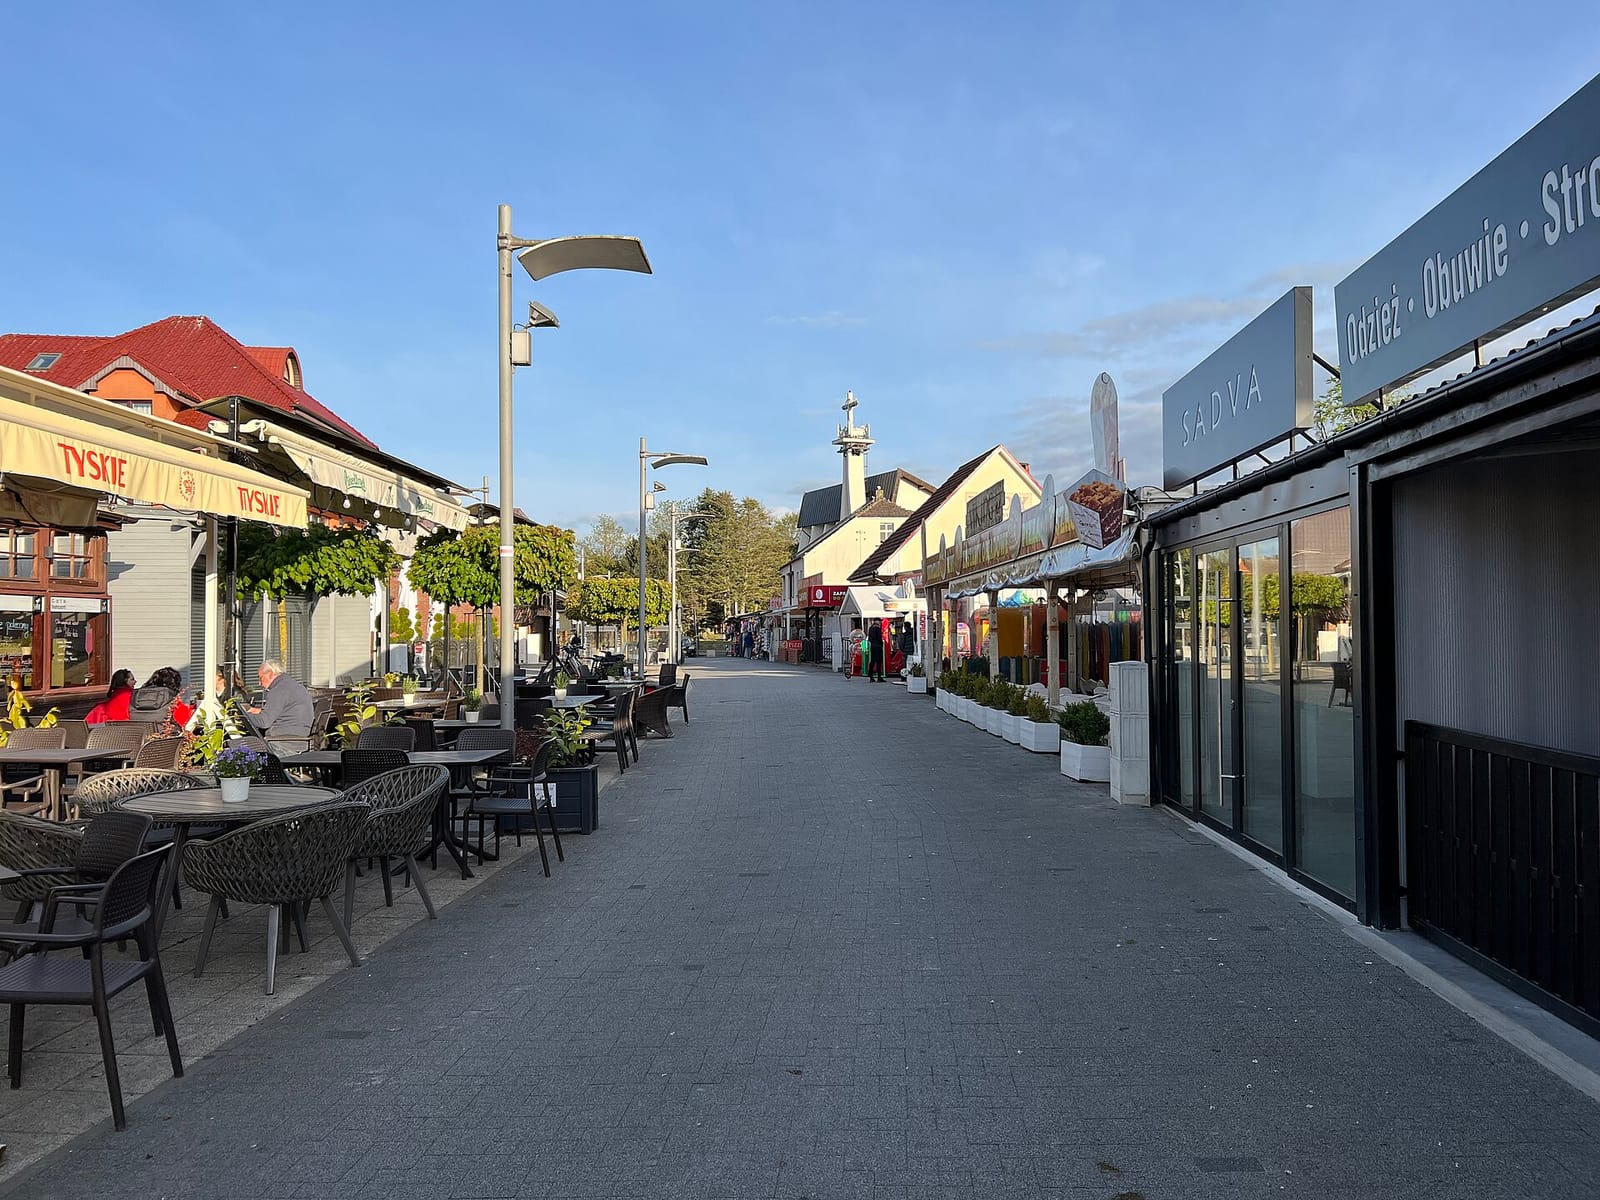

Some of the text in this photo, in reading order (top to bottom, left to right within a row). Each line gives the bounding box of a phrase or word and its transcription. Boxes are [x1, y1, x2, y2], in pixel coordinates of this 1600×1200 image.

[1346, 284, 1401, 365] Odzież
[1422, 217, 1509, 319] Obuwie
[1181, 363, 1262, 447] SADVA
[57, 443, 128, 488] TYSKIE
[237, 486, 281, 518] TYSKIE
